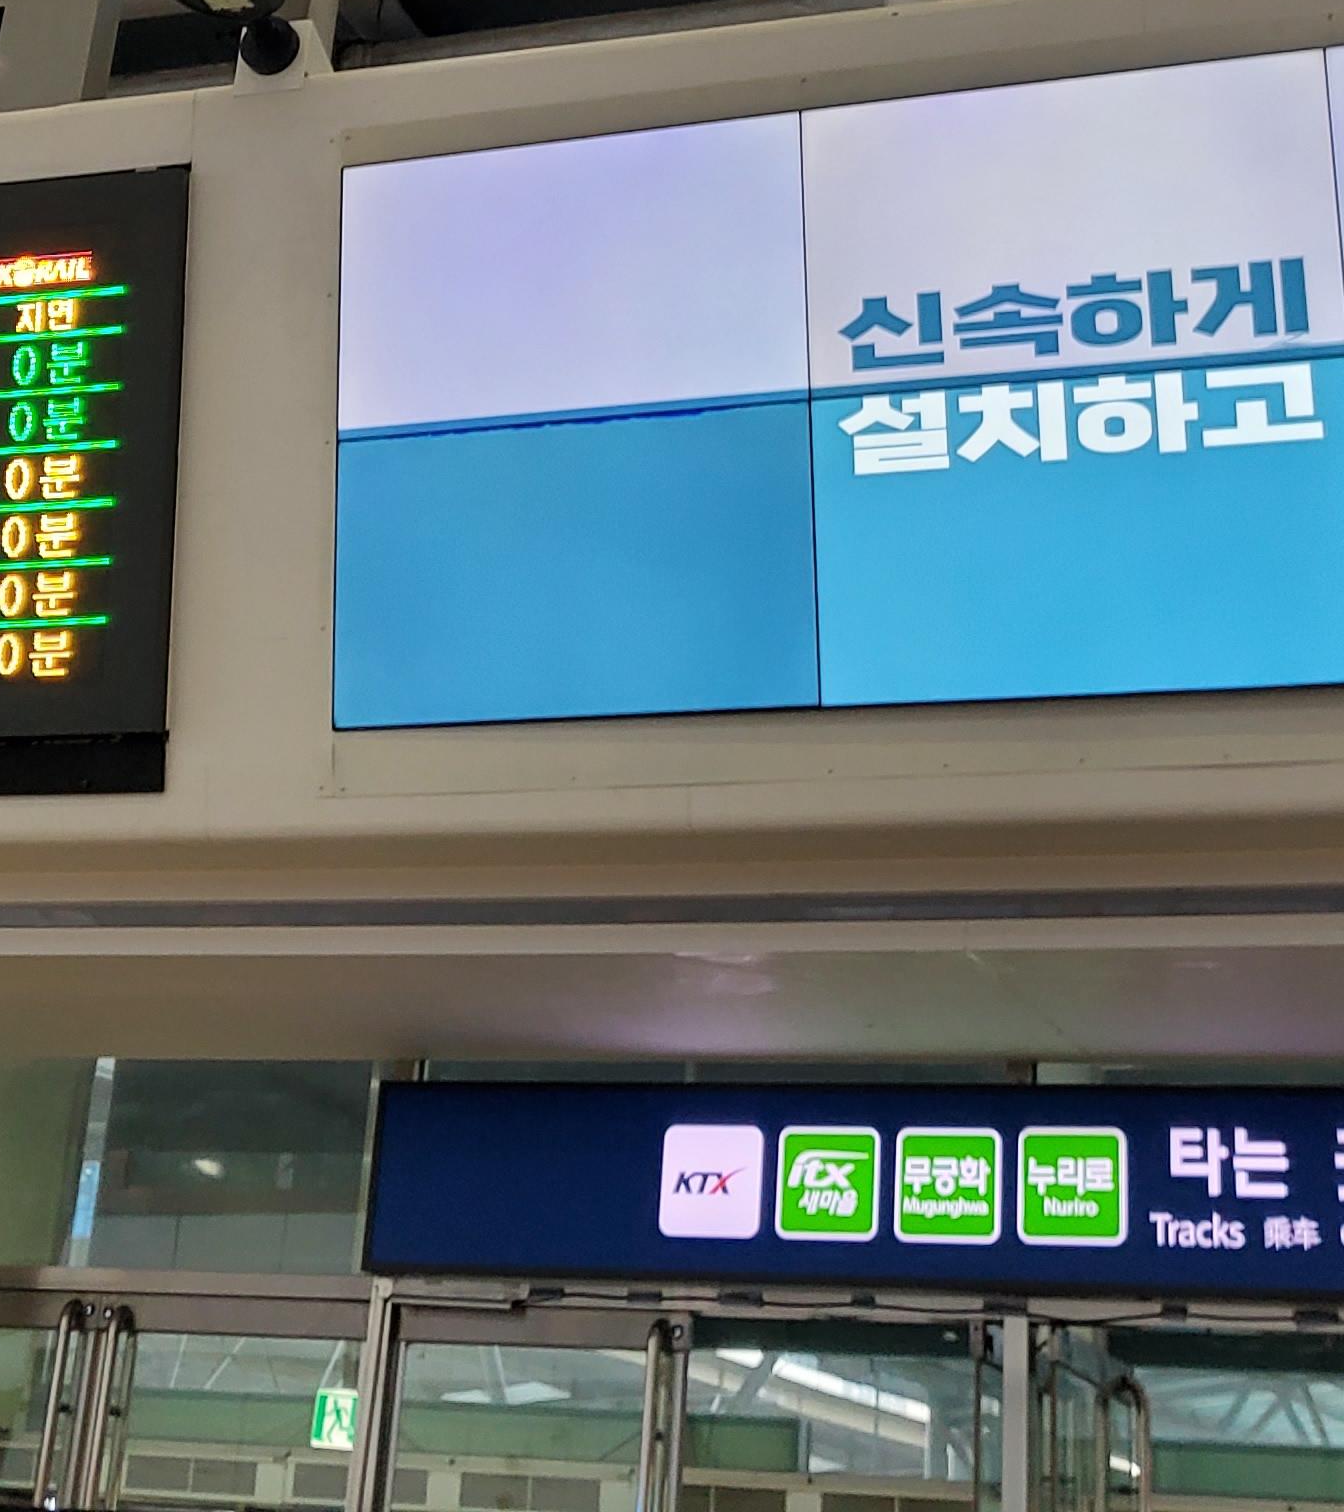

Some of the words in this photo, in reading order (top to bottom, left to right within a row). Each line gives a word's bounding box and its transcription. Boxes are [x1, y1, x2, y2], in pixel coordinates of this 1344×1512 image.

[16, 299, 76, 333] 지연
[839, 255, 1311, 372] 신속하게
[839, 363, 1325, 476] 설치하고
[673, 1167, 747, 1195] KTX
[904, 1154, 991, 1197] 무궁화
[1027, 1156, 1115, 1197] 누리로
[1169, 1126, 1290, 1199] 타는
[798, 1188, 858, 1217] 새마을
[902, 1196, 990, 1219] Mugunghwa
[1043, 1196, 1100, 1217] Nuriro
[1149, 1210, 1247, 1250] Tracks
